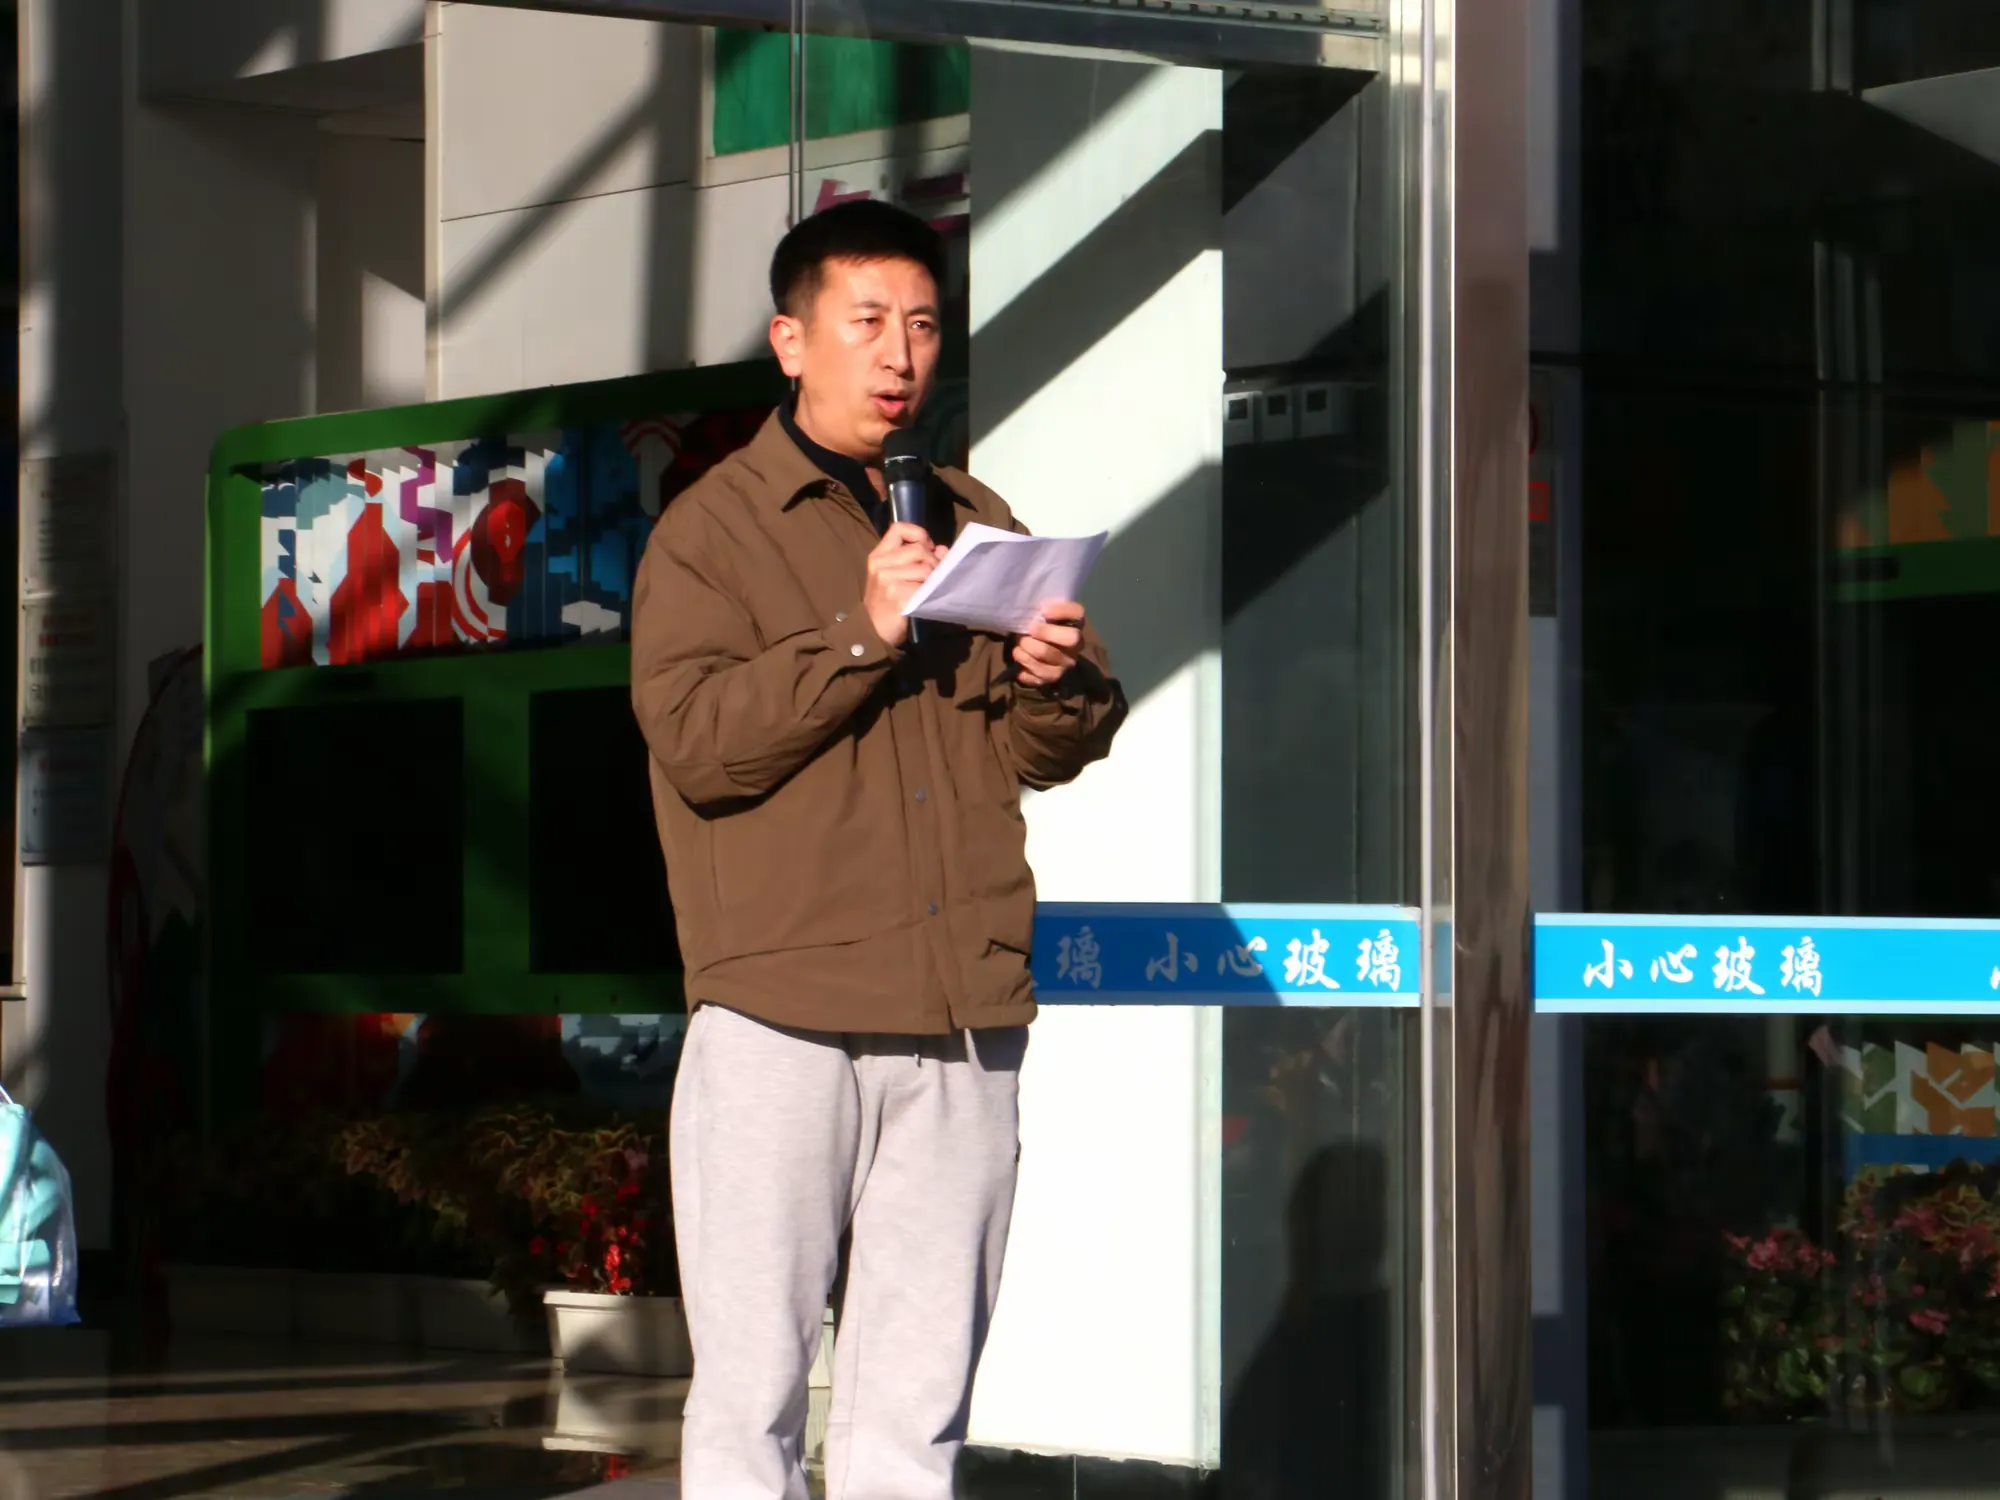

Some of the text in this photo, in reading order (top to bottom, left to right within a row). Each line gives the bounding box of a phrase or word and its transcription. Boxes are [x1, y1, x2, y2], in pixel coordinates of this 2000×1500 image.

[1034, 925, 1401, 992] 璃 小心玻璃
[1582, 935, 1824, 997] 小心玻璃
